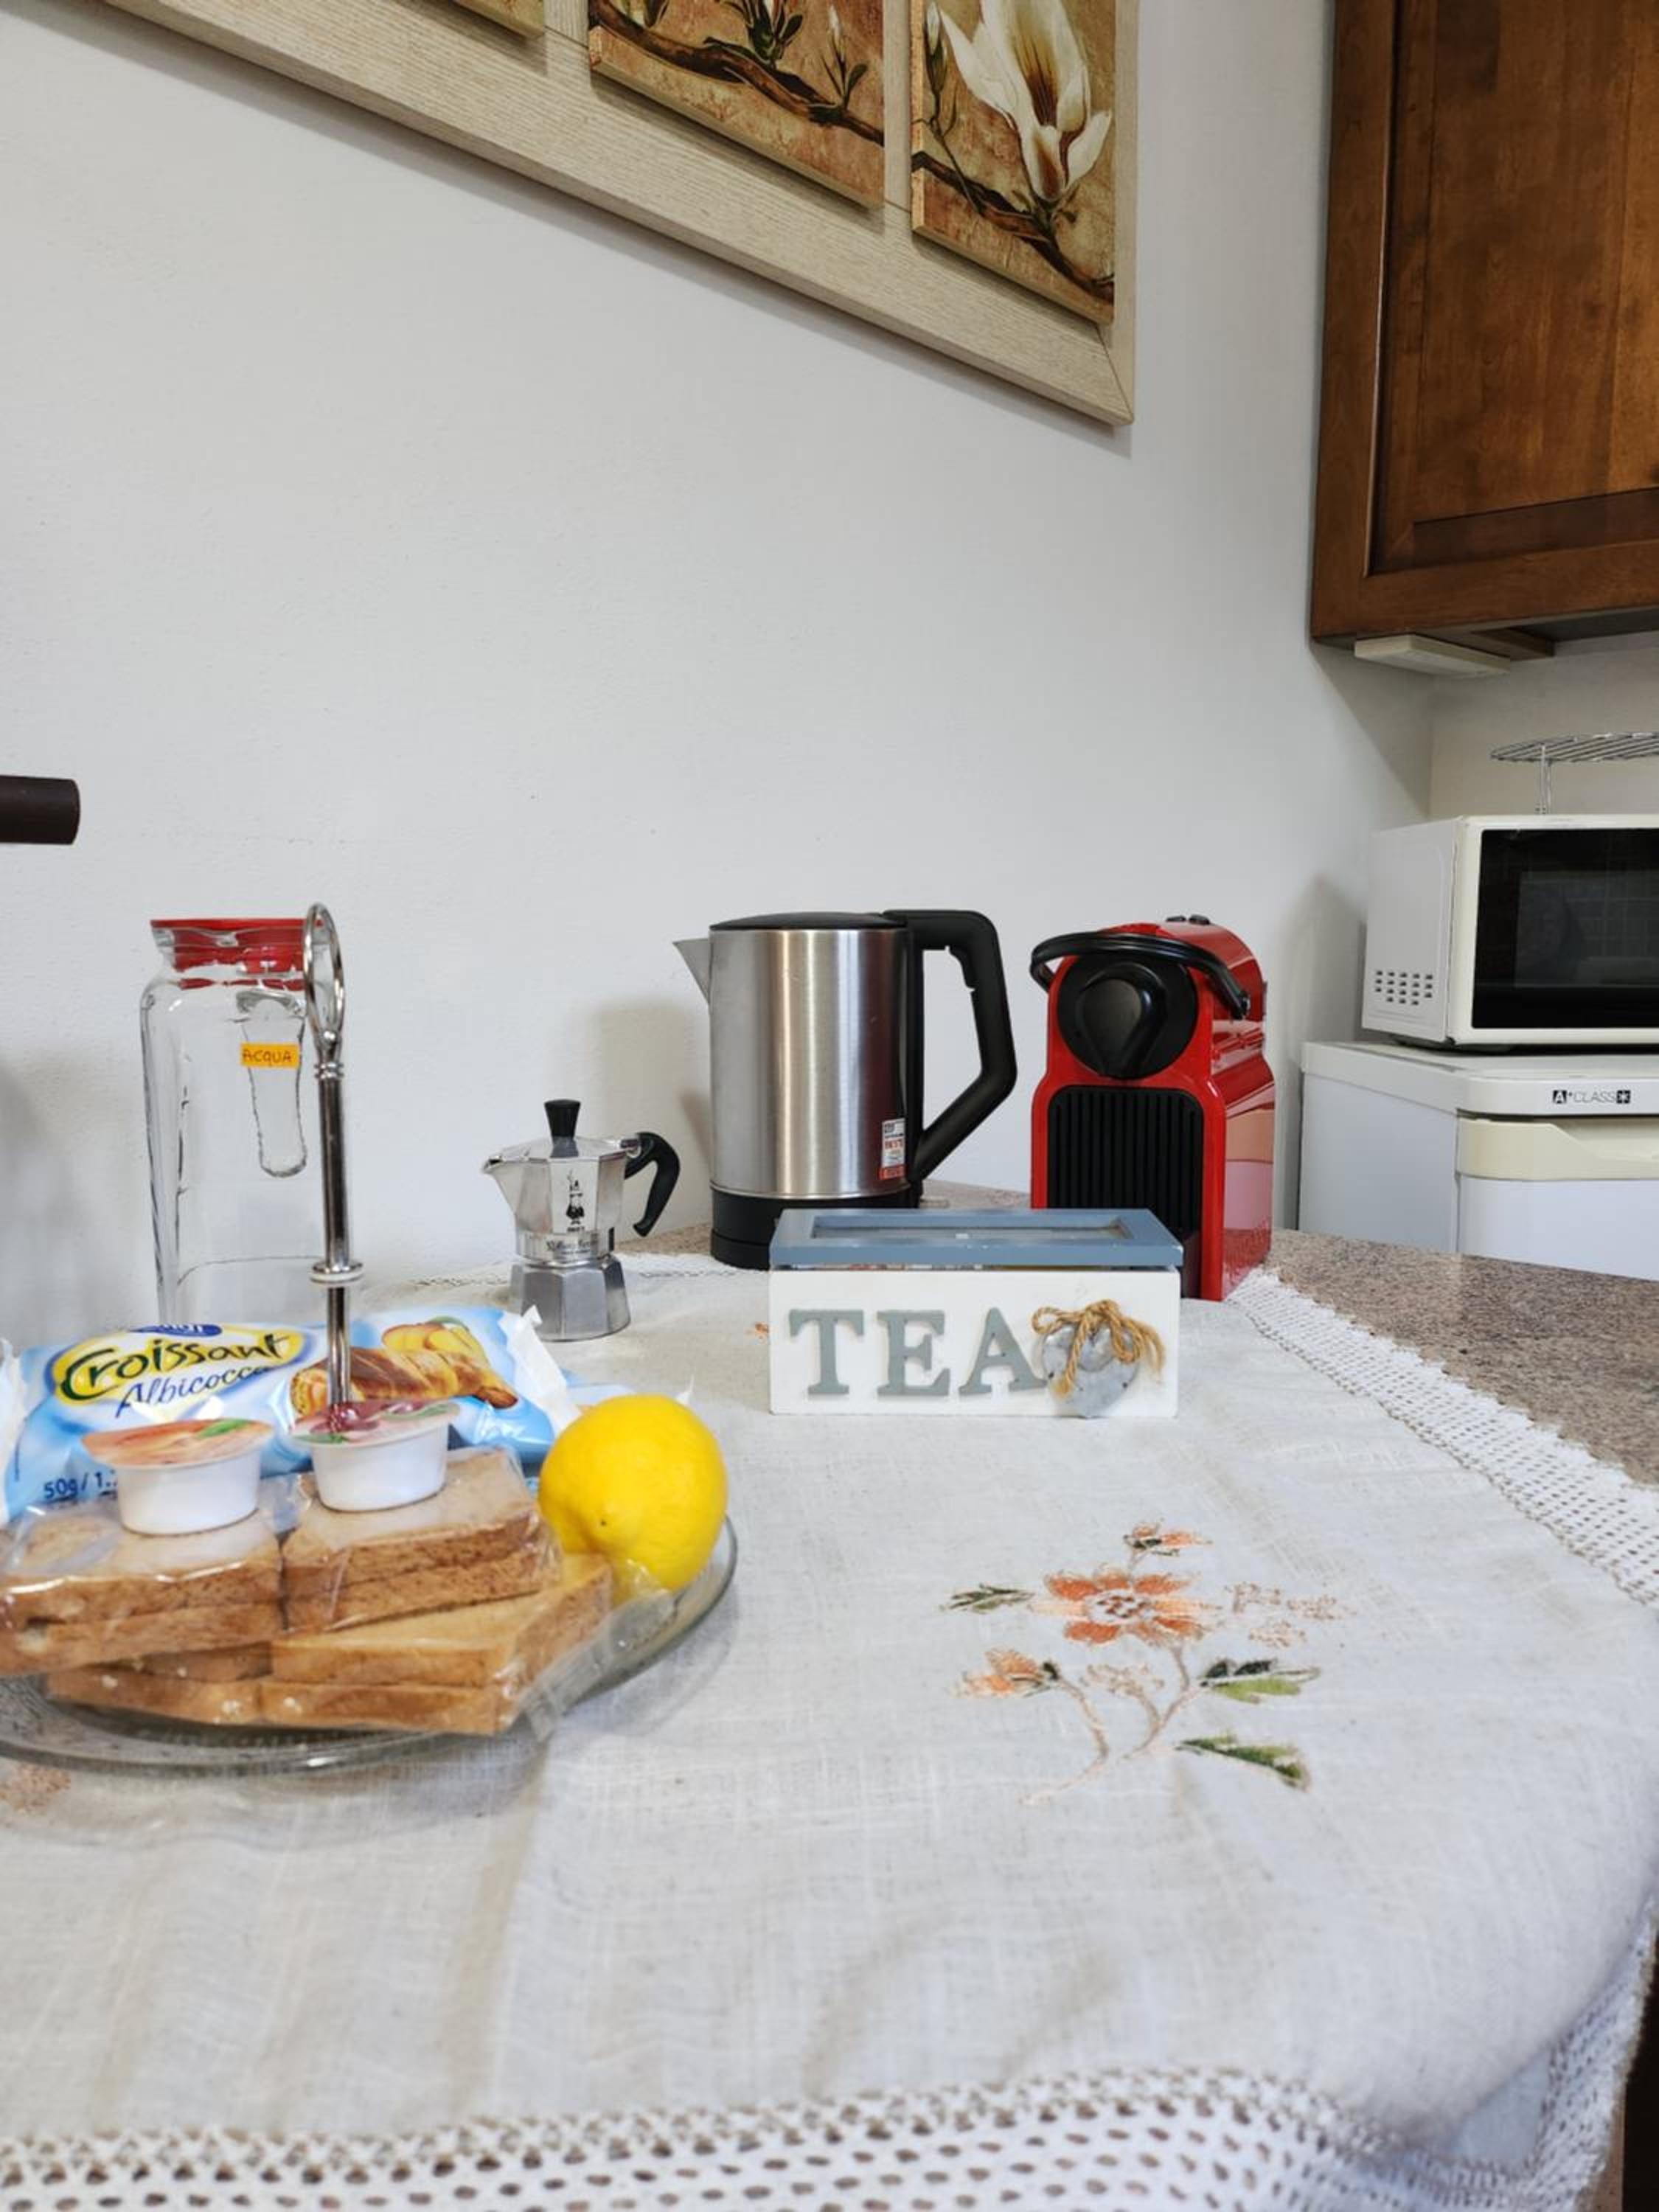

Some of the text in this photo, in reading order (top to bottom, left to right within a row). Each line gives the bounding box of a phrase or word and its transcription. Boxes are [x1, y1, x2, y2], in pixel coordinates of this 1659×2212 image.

[242, 1048, 293, 1066] ACQUA
[60, 1333, 290, 1401] Croissant
[788, 1307, 1048, 1397] TEA
